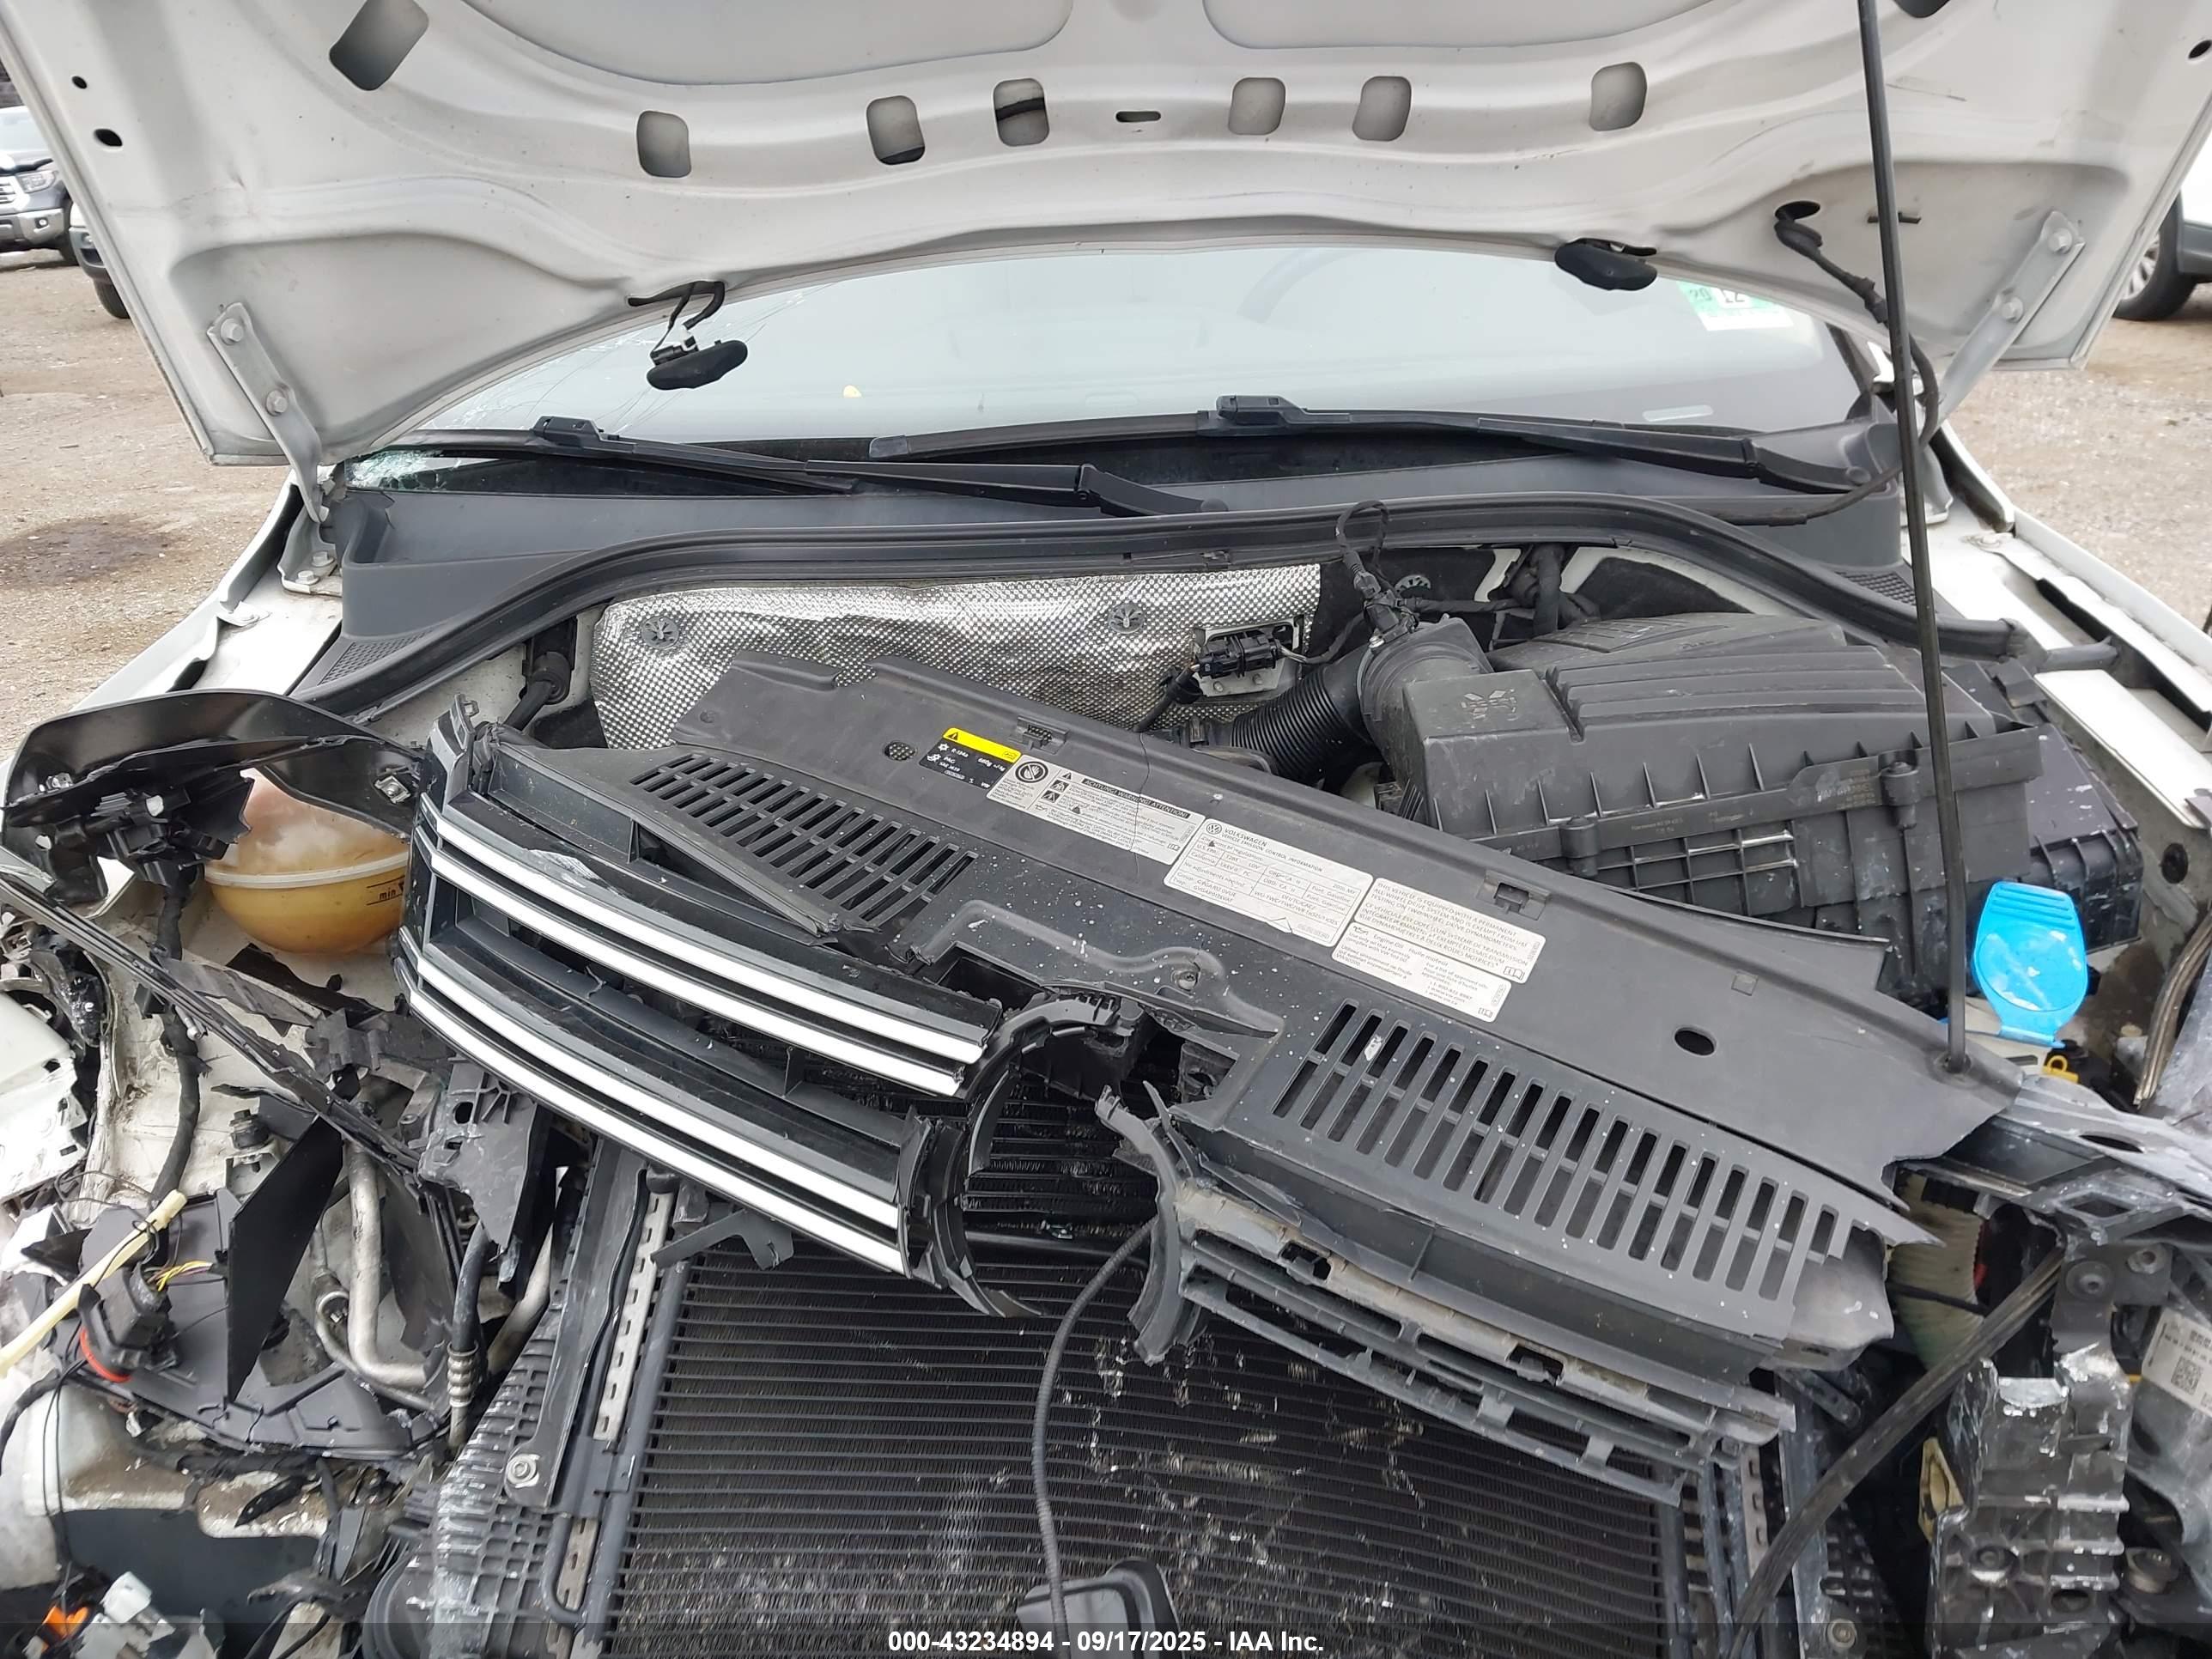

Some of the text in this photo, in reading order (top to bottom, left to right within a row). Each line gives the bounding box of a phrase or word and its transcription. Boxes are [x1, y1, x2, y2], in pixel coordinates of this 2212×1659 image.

[1084, 780, 1189, 817] ACHTUNG! WARNING! ATTENTION!
[1224, 828, 1267, 846] VOLKSWAGEN
[1190, 851, 1216, 863] California
[1221, 833, 1322, 872] VEHICLE EMISSION CONTROL INFORMATION
[380, 887, 396, 901] min
[1370, 893, 1395, 905] TESTING
[1445, 921, 1464, 931] DRIVE
[1391, 888, 1414, 899] VEHICLE
[1423, 899, 1455, 914] EQUIPPED
[1478, 919, 1516, 936] PERMANENT
[1407, 900, 1425, 909] DRIVE
[1425, 907, 1449, 918] SYSTEM
[1449, 915, 1464, 924] AND
[1471, 923, 1495, 935] EXEMPT
[1372, 934, 1394, 945] Engine
[1408, 947, 1425, 957] Huile
[1481, 945, 1528, 966] TRANSMISSION
